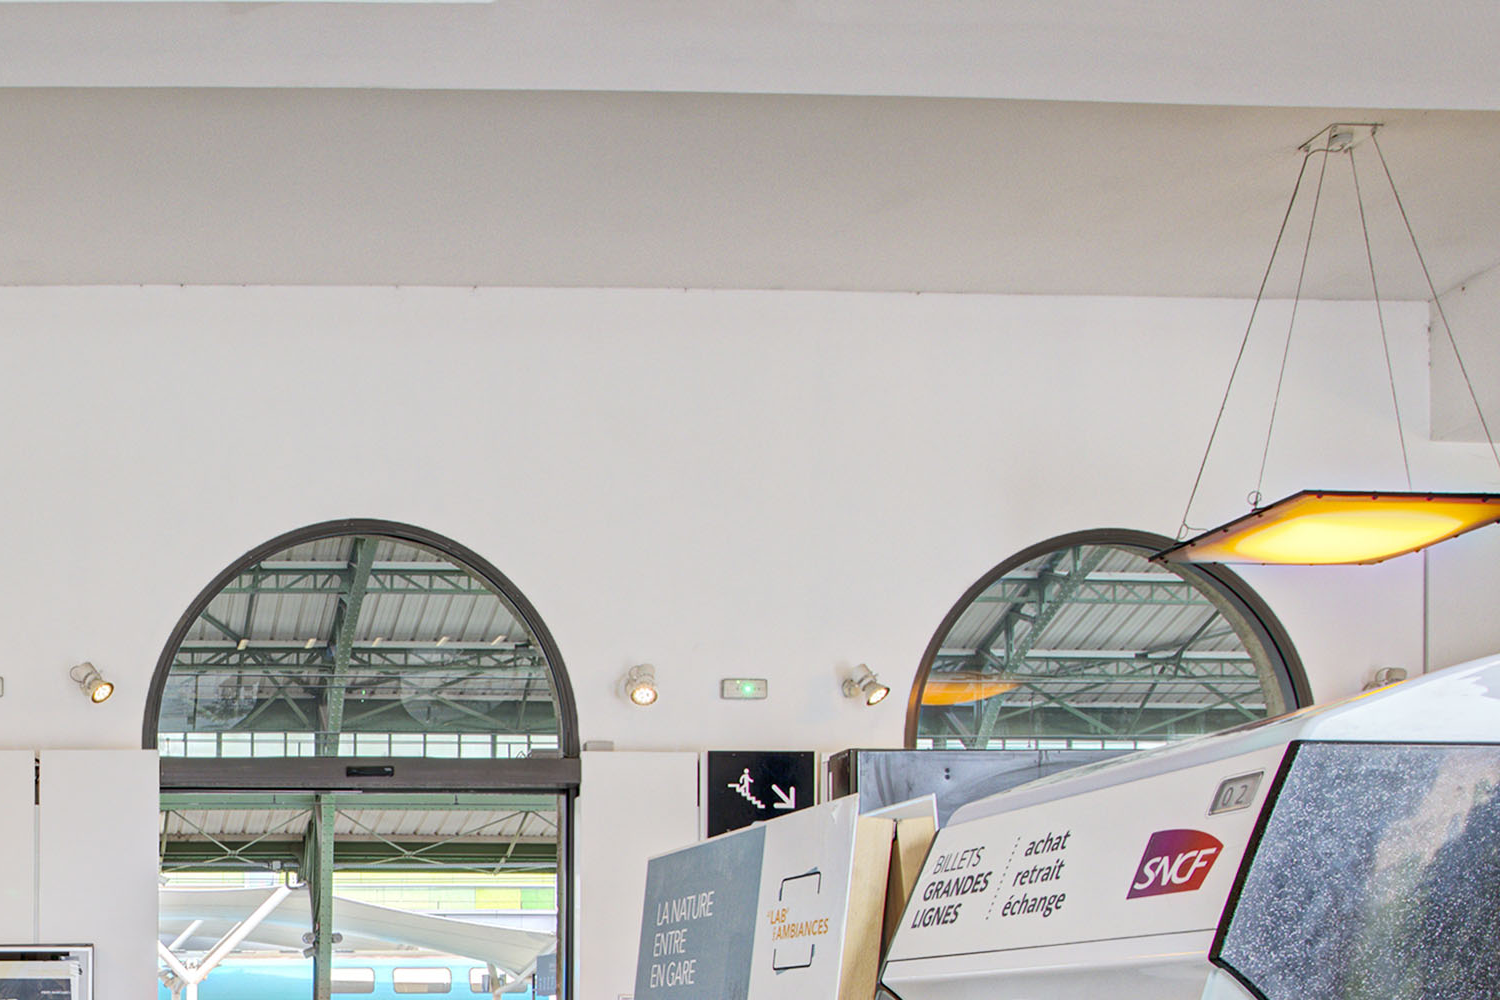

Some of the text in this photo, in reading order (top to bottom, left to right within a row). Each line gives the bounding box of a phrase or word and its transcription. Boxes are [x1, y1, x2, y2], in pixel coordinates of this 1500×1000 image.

[1024, 829, 1072, 858] achat
[932, 845, 986, 875] BILLETS
[1012, 859, 1065, 888] retrait
[1133, 847, 1218, 891] SNCF
[922, 870, 994, 902] GRANDES
[656, 890, 715, 926] LA NATURE
[910, 902, 962, 930] LIGNES
[1001, 890, 1067, 919] échange
[653, 928, 688, 957] ENTRE
[776, 918, 829, 940] AMBIANCES
[650, 959, 697, 989] EN GARE
